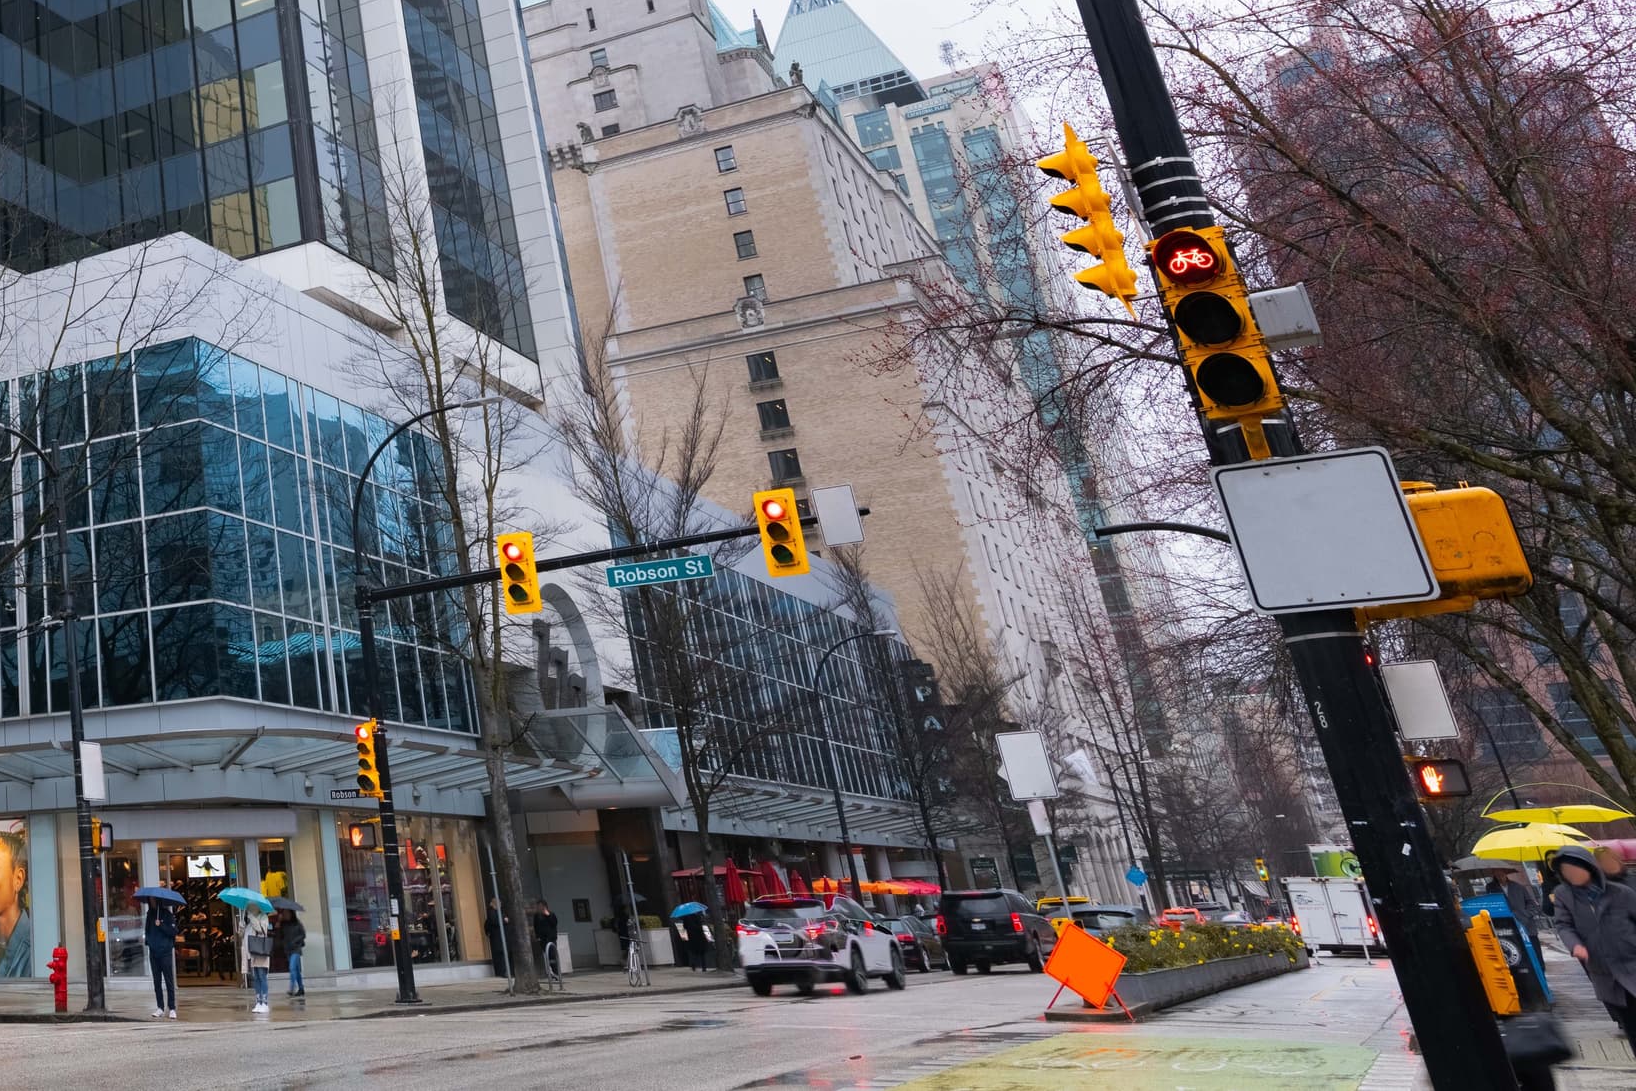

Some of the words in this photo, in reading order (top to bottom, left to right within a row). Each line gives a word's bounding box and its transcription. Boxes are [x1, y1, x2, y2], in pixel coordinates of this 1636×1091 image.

[613, 565, 678, 584] Robson
[684, 560, 705, 575] St
[1314, 701, 1329, 729] 28
[331, 791, 357, 799] Robson
